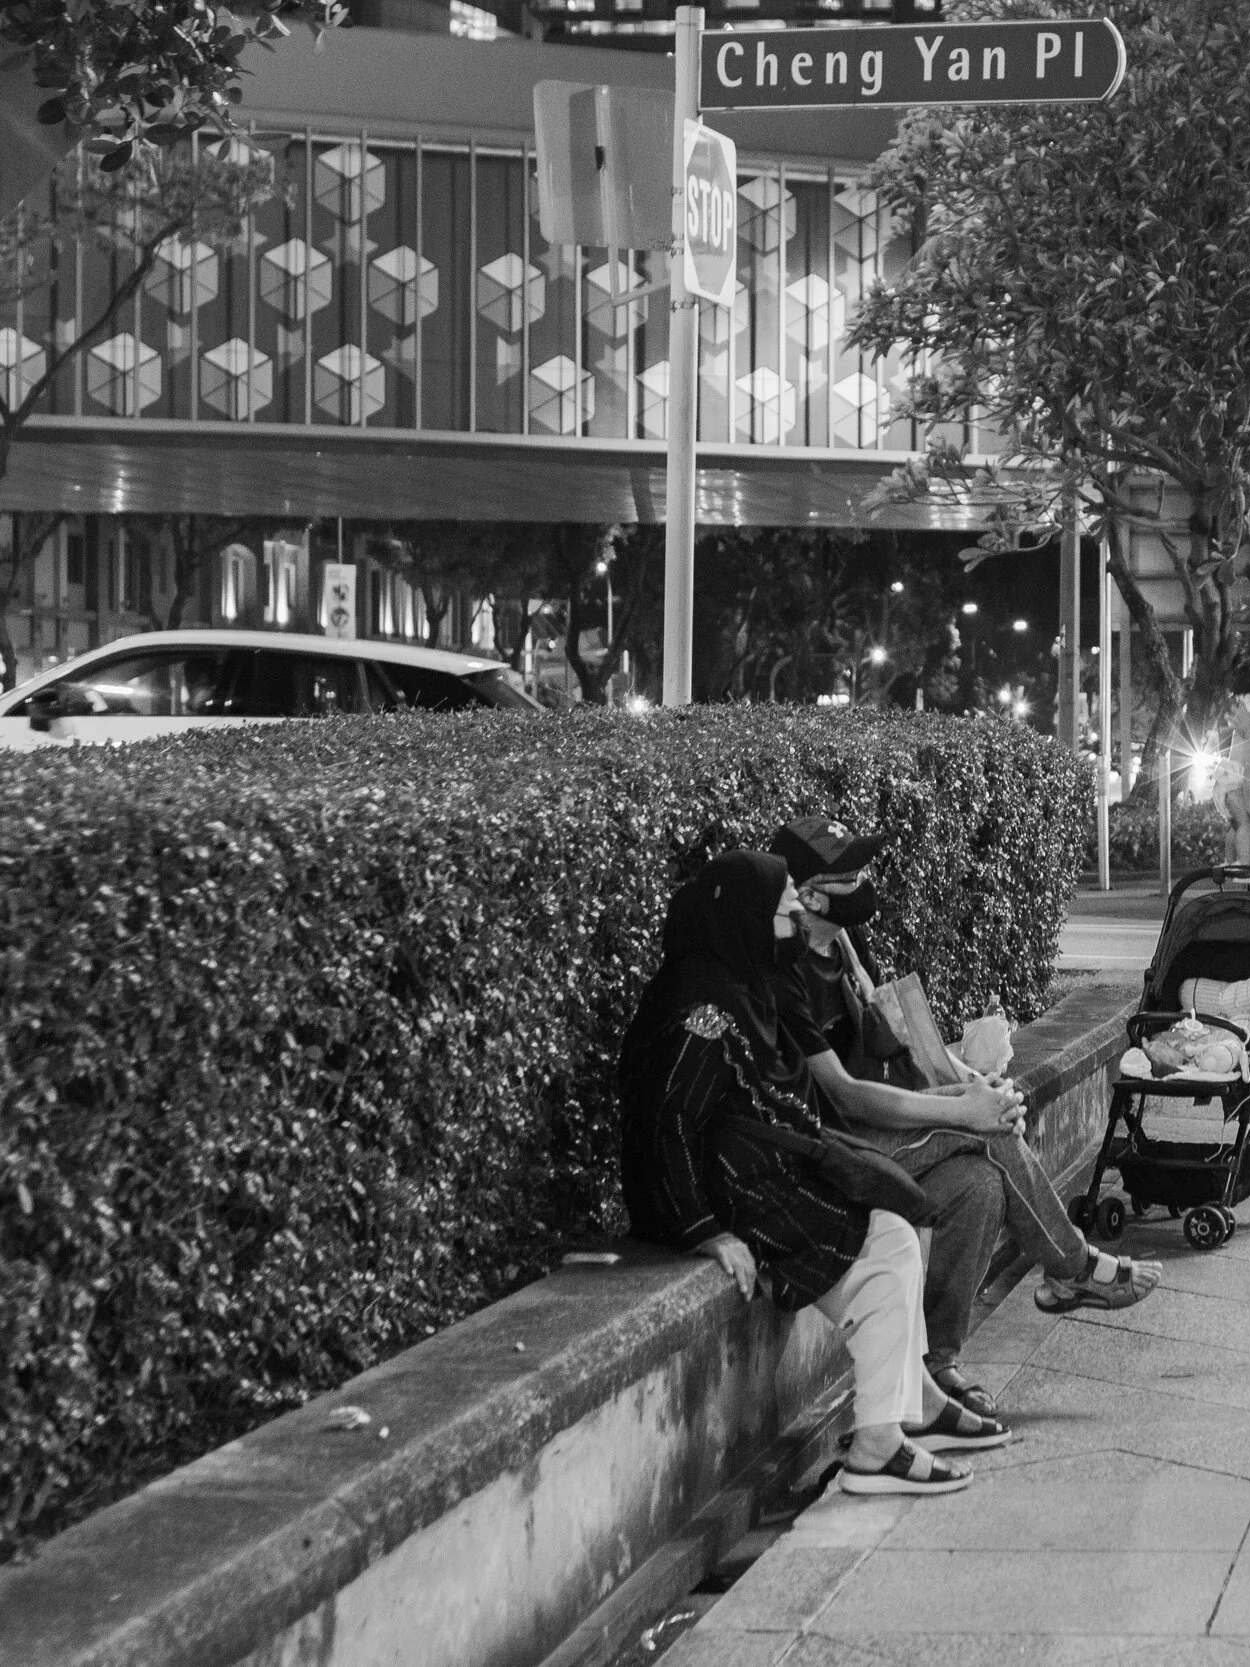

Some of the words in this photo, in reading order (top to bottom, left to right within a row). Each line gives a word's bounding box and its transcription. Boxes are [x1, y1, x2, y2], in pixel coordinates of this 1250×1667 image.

[717, 41, 884, 95] Cheng
[914, 34, 1006, 82] Yan
[1034, 31, 1085, 79] Pl
[686, 174, 734, 252] STOP
